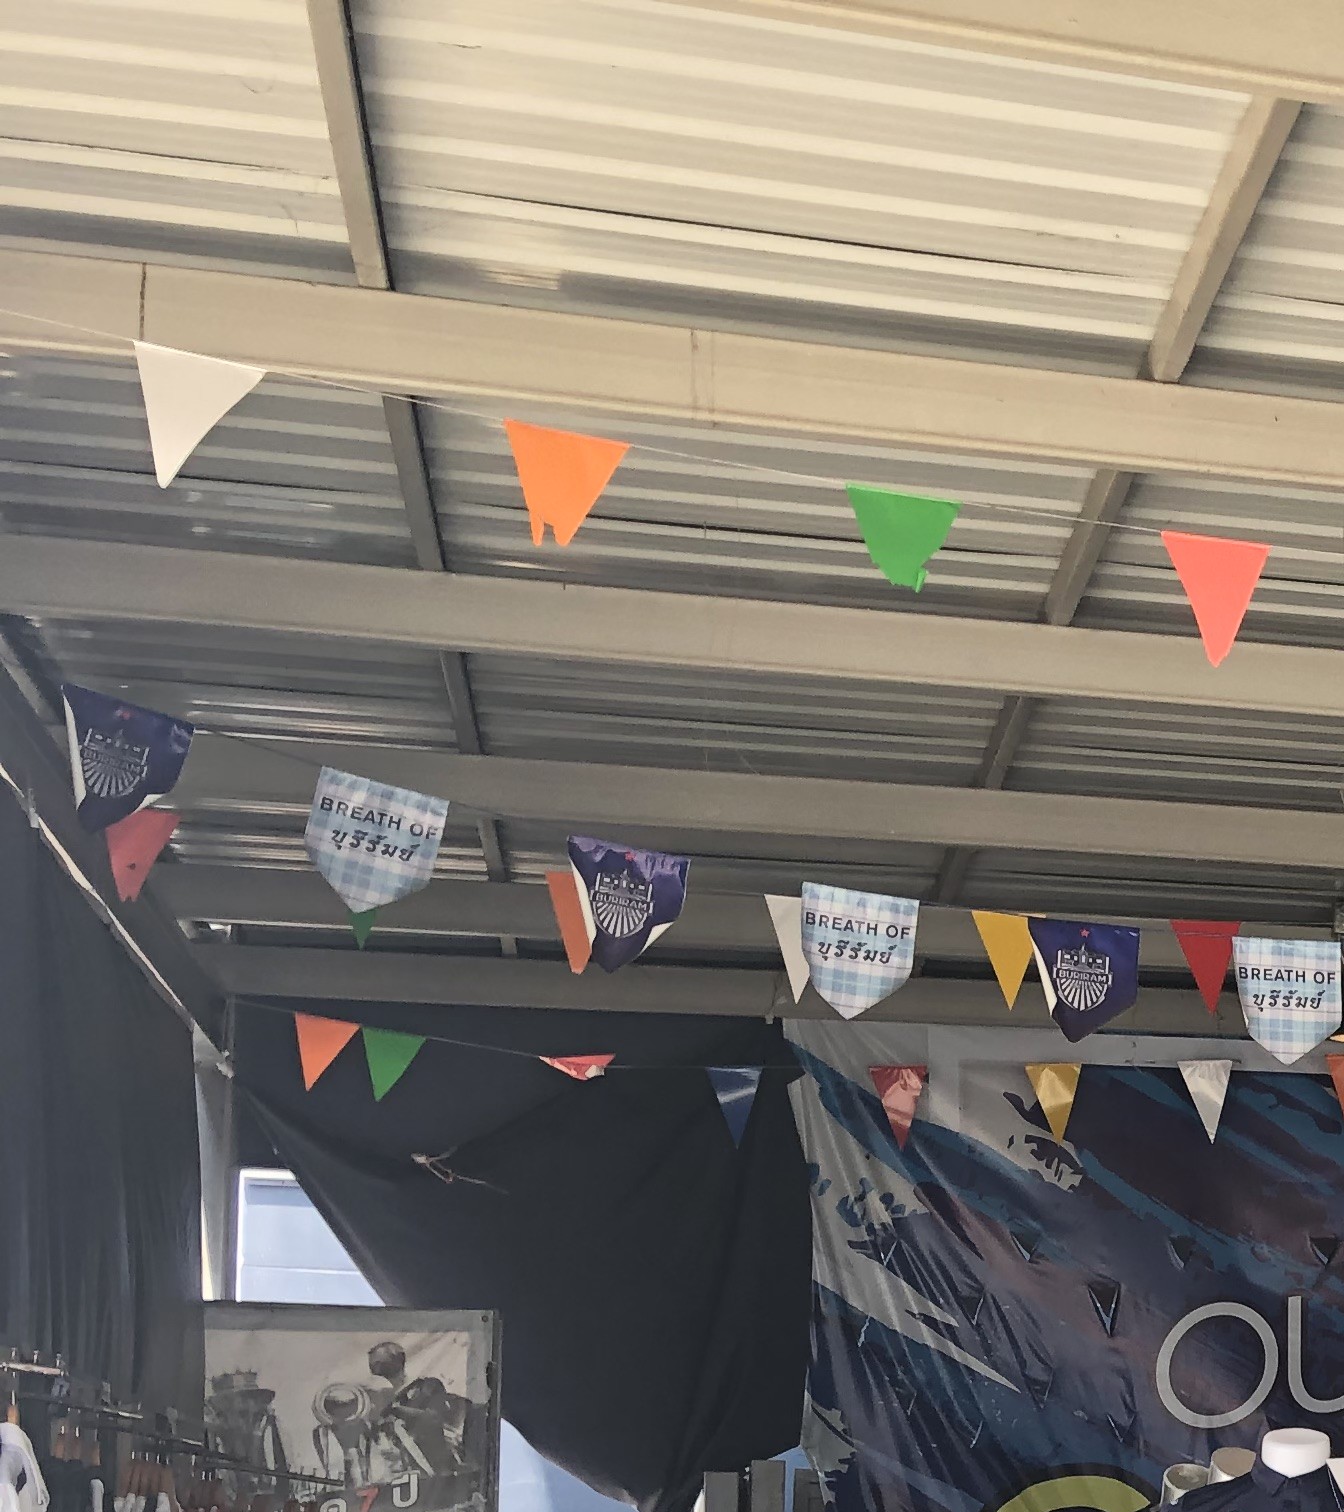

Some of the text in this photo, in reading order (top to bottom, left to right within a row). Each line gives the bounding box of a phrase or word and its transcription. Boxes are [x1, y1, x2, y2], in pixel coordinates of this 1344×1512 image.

[320, 796, 438, 840] BREATH OF
[805, 911, 911, 940] BREATH OF
[1058, 969, 1107, 983] BURIRAM
[1238, 966, 1336, 985] BREATH OF
